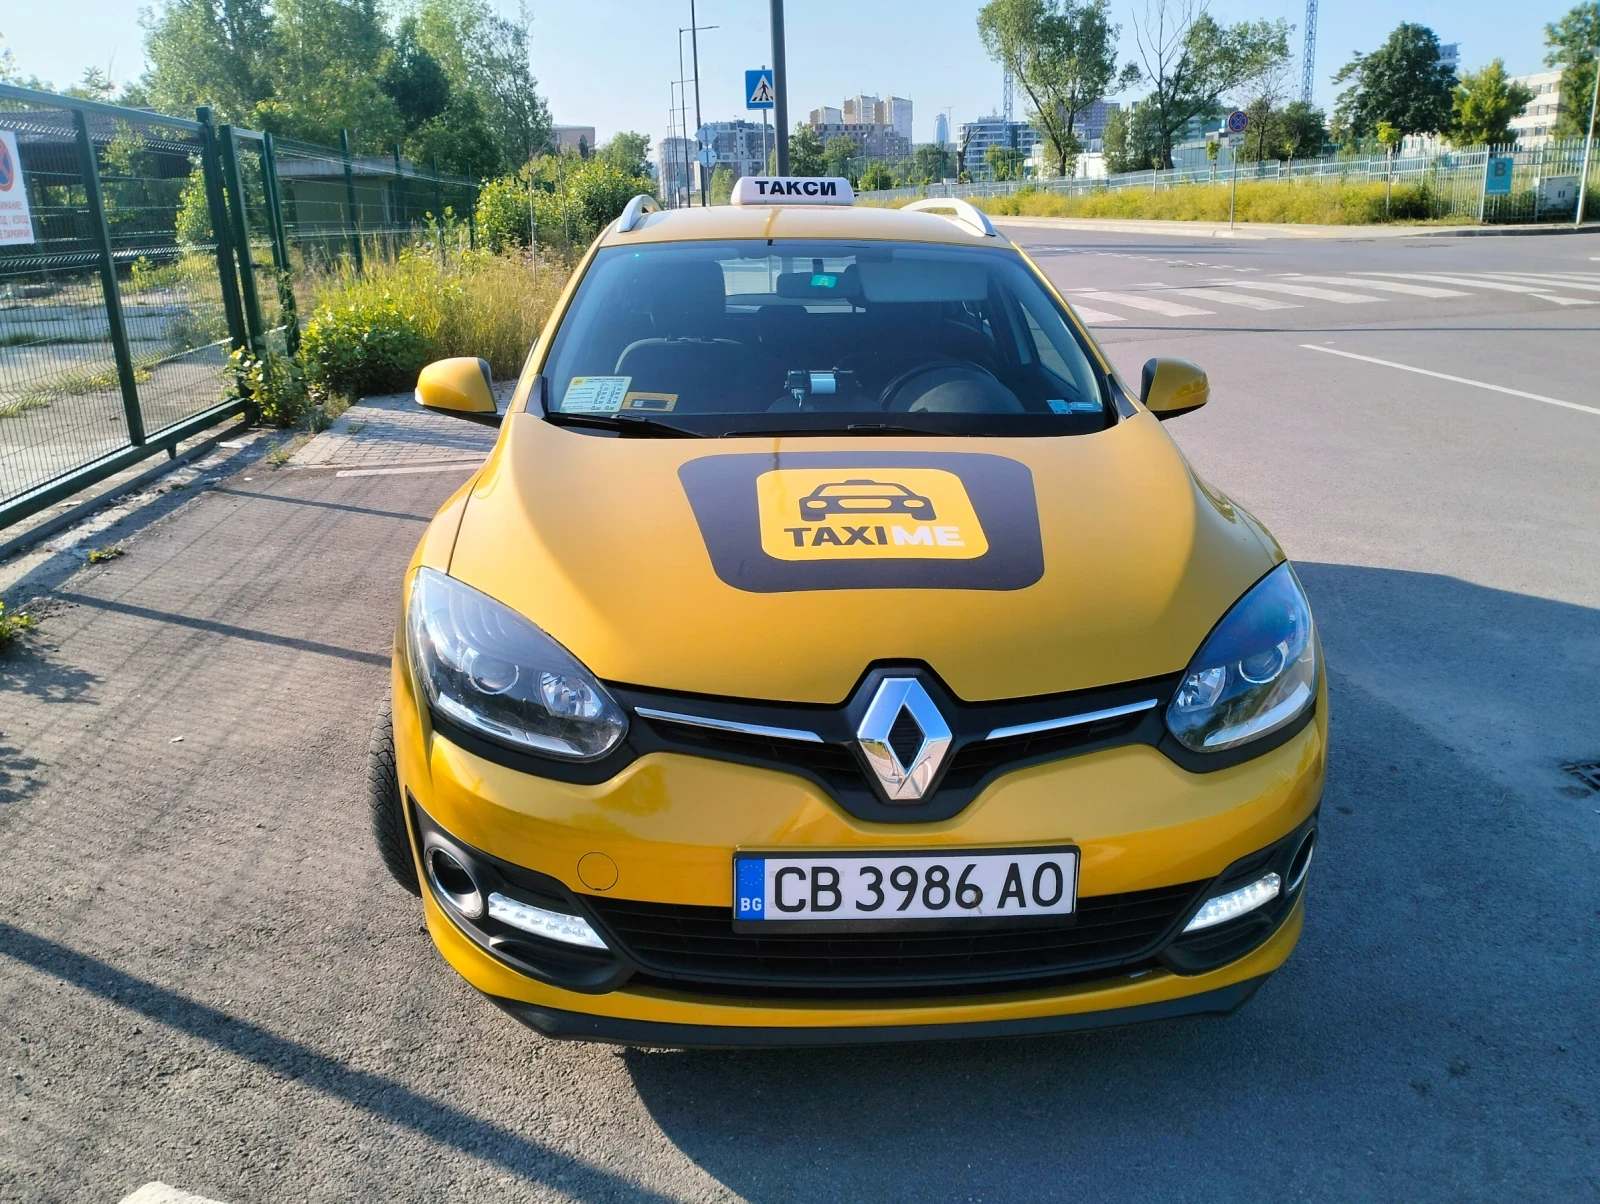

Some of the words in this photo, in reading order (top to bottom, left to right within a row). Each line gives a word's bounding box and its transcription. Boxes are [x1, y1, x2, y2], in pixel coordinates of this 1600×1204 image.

[1494, 161, 1507, 177] B
[755, 181, 836, 196] ТАКСИ
[774, 866, 842, 912] CB
[855, 864, 984, 912] 3986
[997, 861, 1063, 909] AO
[740, 897, 762, 912] BG
